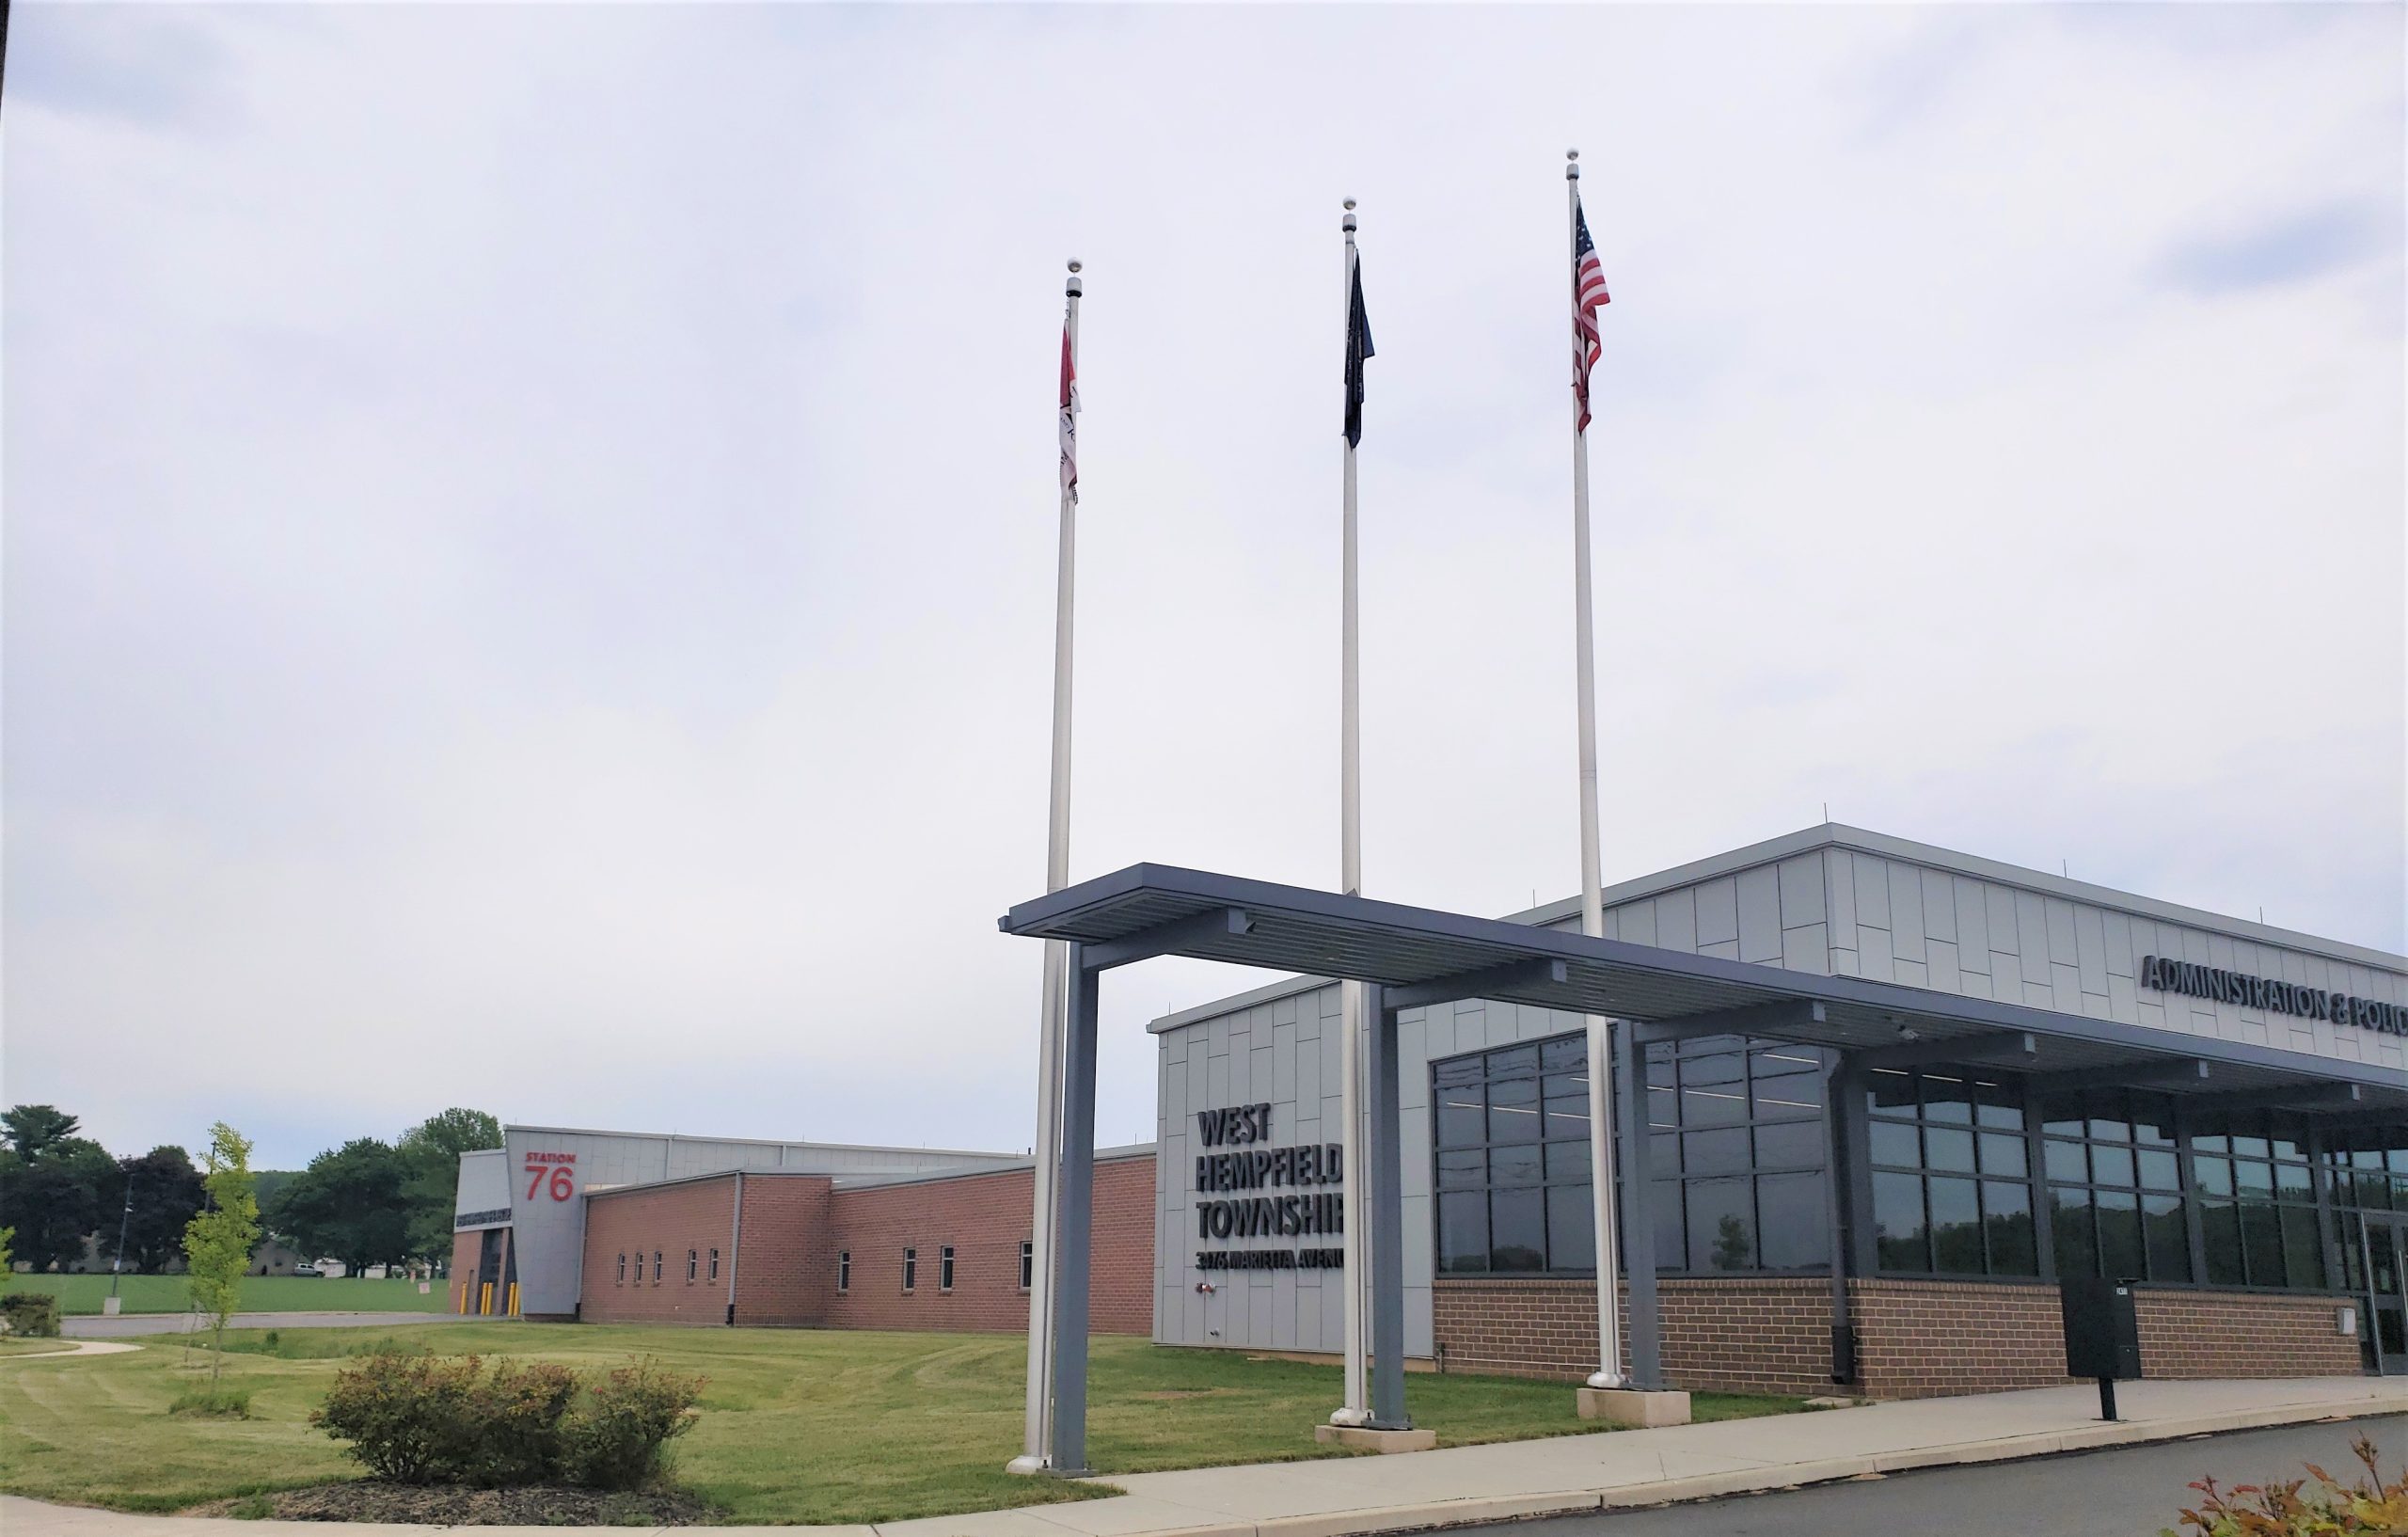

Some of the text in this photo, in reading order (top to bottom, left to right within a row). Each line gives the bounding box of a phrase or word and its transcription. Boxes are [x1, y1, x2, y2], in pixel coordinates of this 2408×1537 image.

[2142, 955, 2408, 1038] ADMINISTRATION & POLIC
[1197, 1102, 1271, 1146] WEST
[526, 1151, 577, 1164] STATION
[1196, 1143, 1343, 1192] HEMPFIELD
[525, 1165, 573, 1202] 76
[1297, 1248, 1344, 1269] AVENU
